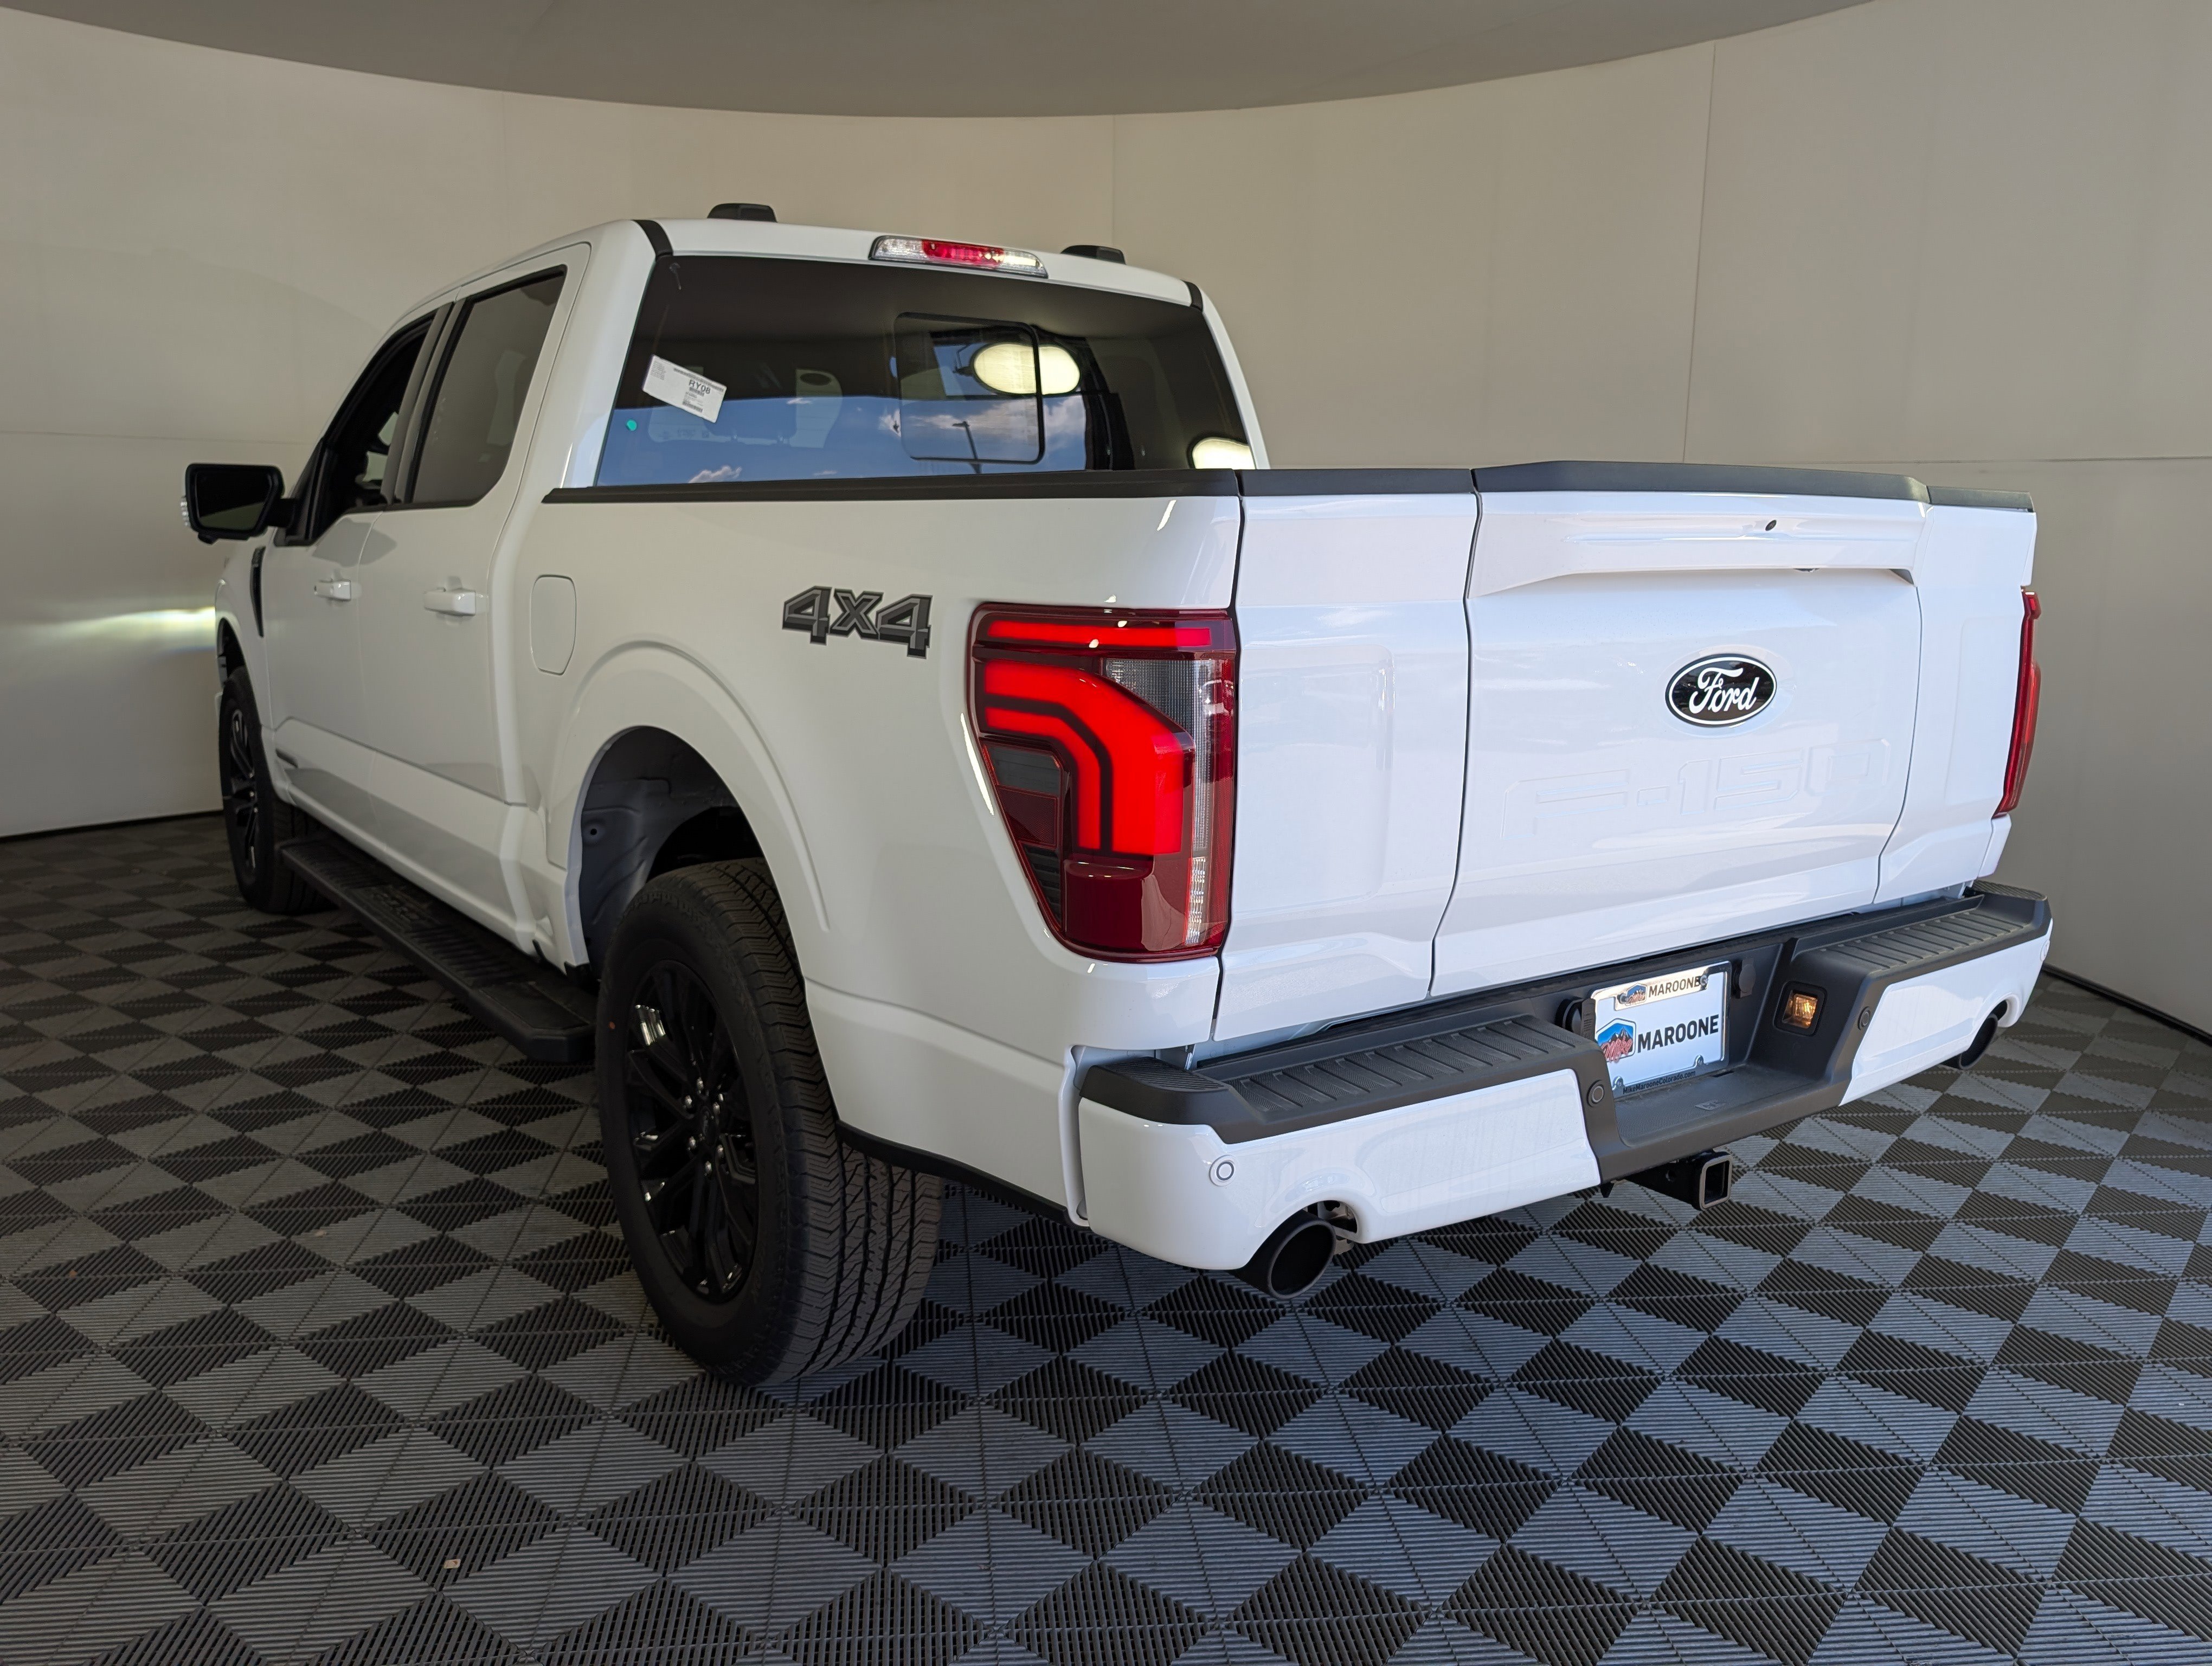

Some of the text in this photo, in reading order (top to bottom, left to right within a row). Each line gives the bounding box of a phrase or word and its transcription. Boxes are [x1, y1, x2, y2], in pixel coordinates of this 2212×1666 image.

[689, 379, 711, 394] RY08
[1689, 667, 1760, 714] Ford
[1501, 739, 1891, 840] F-150
[1649, 976, 1700, 998] MAROONE
[1601, 1014, 1719, 1063] Mike MAROONE
[1623, 1071, 1696, 1094] MikeMarooneColorado.com
